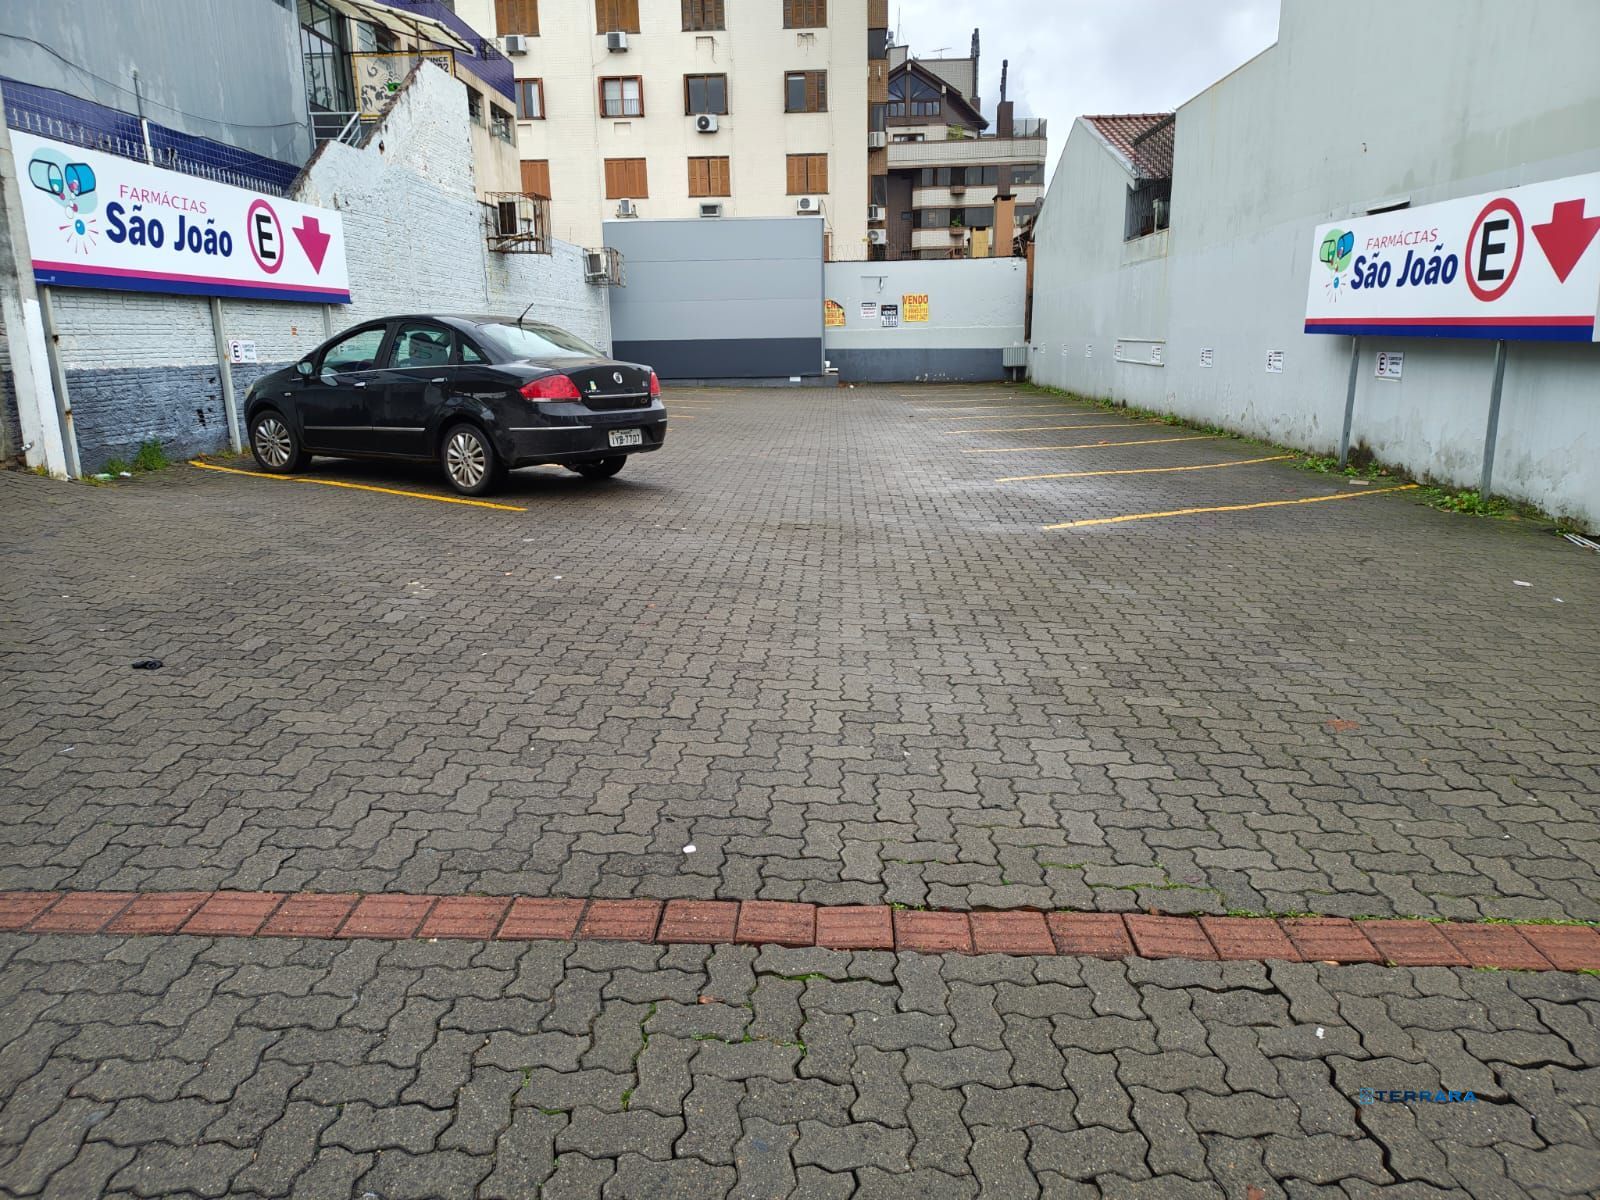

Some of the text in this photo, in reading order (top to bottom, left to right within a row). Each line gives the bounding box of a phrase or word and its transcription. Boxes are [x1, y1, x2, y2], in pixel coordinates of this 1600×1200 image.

[119, 184, 208, 214] FARMÁCIAS
[106, 201, 233, 257] São João
[255, 213, 276, 260] E
[1366, 228, 1438, 250] FARMÁCIAS
[1477, 218, 1510, 282] E
[1350, 243, 1458, 290] São João
[902, 295, 928, 304] VENDO
[233, 345, 240, 358] E
[1379, 357, 1385, 371] E
